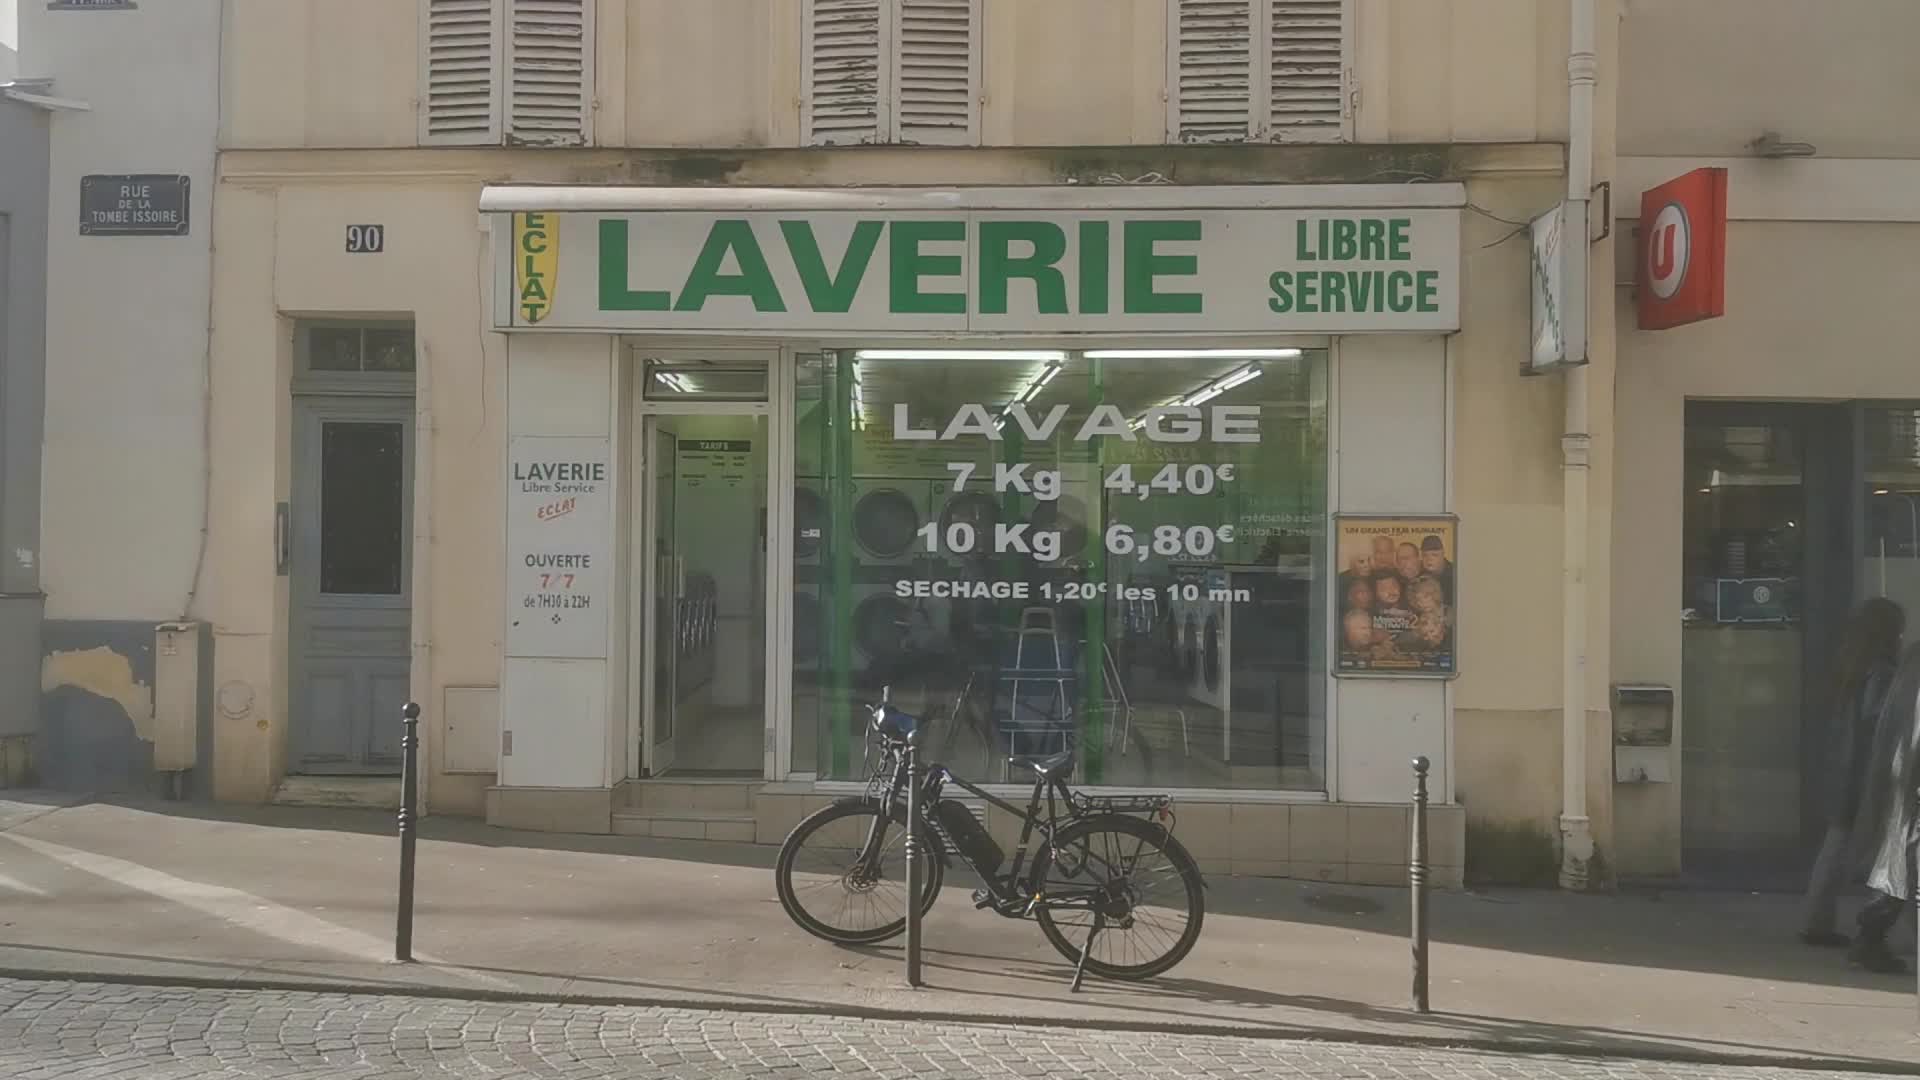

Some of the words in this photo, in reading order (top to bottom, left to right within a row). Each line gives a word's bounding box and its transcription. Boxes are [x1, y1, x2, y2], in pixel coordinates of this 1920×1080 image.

[120, 185, 151, 198] RUE
[118, 200, 132, 209] DE
[138, 200, 151, 209] LA
[92, 210, 129, 223] TOMBE
[133, 210, 178, 223] ISSOIRE
[348, 226, 380, 251] 90
[1296, 218, 1411, 261] LIBRE
[598, 219, 1203, 314] LAVERIE
[1268, 270, 1439, 313] SERVICE
[893, 403, 1261, 443] LAVAGE
[514, 462, 605, 481] LAVERIE
[947, 462, 976, 492] 7
[995, 463, 1062, 501] Kg
[1104, 463, 1235, 501] 4,40€
[522, 482, 552, 493] Libre
[554, 482, 595, 493] Service
[537, 497, 576, 519] ECLAT
[917, 521, 975, 553] 10
[995, 523, 1061, 561] Kg
[1105, 524, 1235, 563] 6,80€
[524, 553, 591, 568] OUVERTE
[524, 595, 536, 608] de
[538, 594, 561, 608] 7H30
[564, 595, 569, 608] à
[571, 595, 591, 608] 22H
[895, 580, 1029, 599] SECHAGE
[1116, 583, 1156, 600] les
[1166, 584, 1199, 600] 10
[1208, 588, 1251, 602] mn
